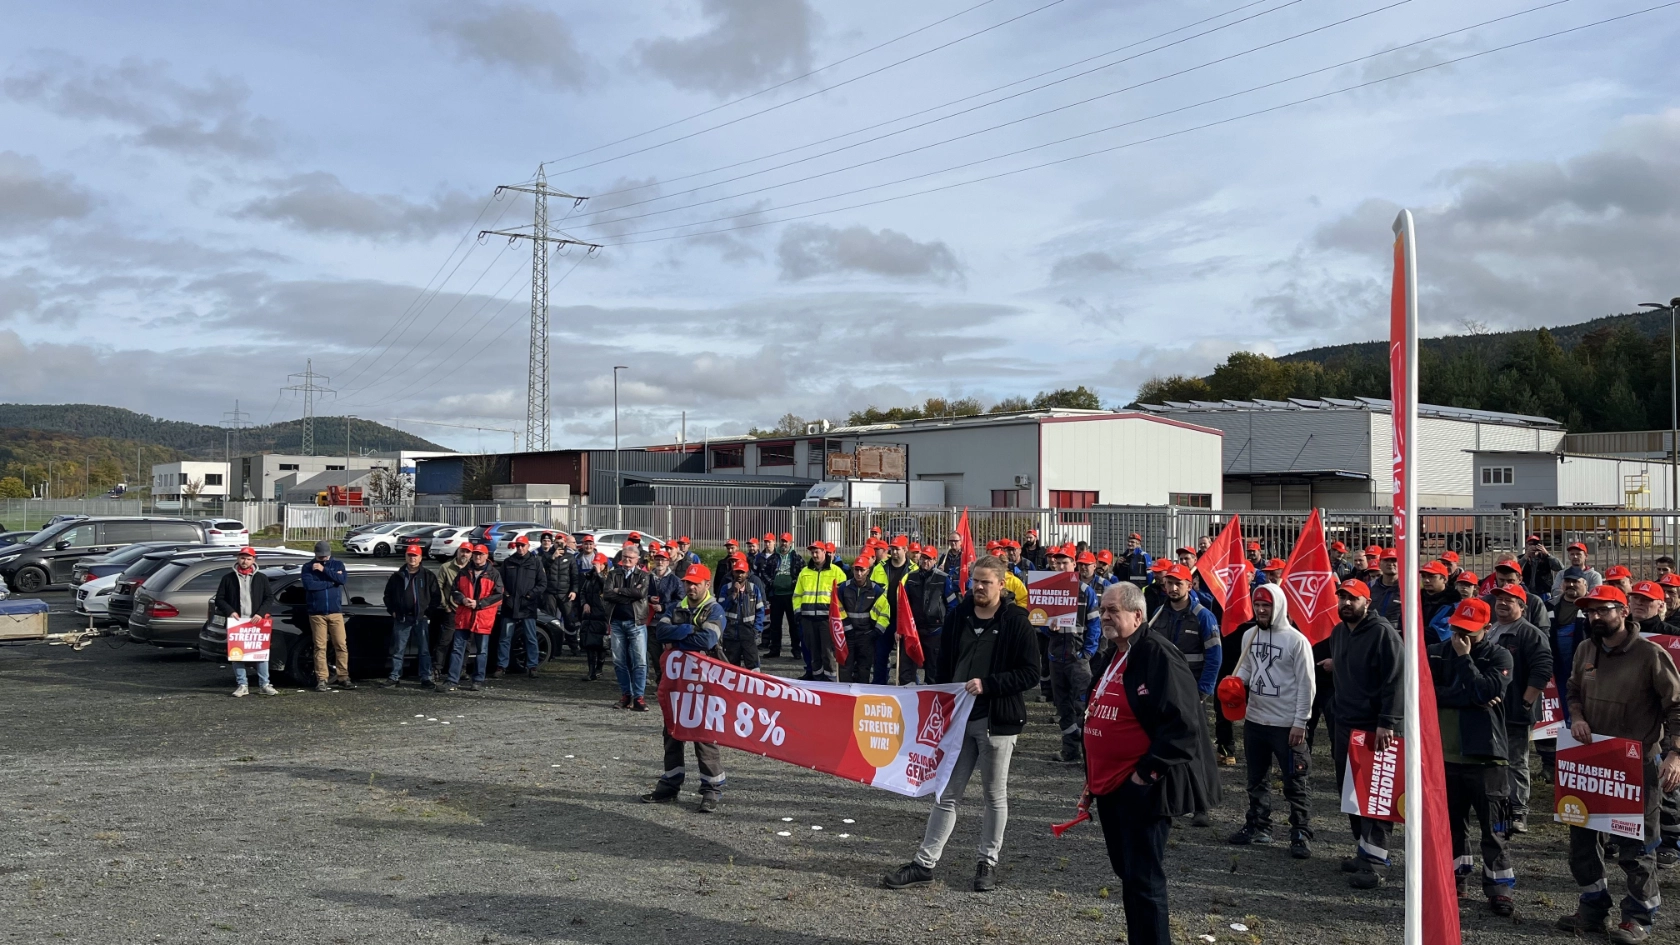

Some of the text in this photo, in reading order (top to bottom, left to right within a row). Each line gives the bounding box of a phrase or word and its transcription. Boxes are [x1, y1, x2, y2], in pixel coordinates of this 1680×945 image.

[1029, 596, 1077, 606] VERDIENT!
[229, 633, 270, 641] STREITEN
[244, 641, 262, 649] WIR
[863, 702, 893, 719] DAFÜR
[1098, 705, 1119, 720] TEAM
[734, 702, 786, 746] 8%
[859, 719, 900, 735] STREITEN
[870, 736, 890, 750] WIR!
[1558, 760, 1626, 782] WIR HABEN ES
[1368, 750, 1384, 815] WIR HABEN ES
[1558, 770, 1641, 802] VERDIENT!
